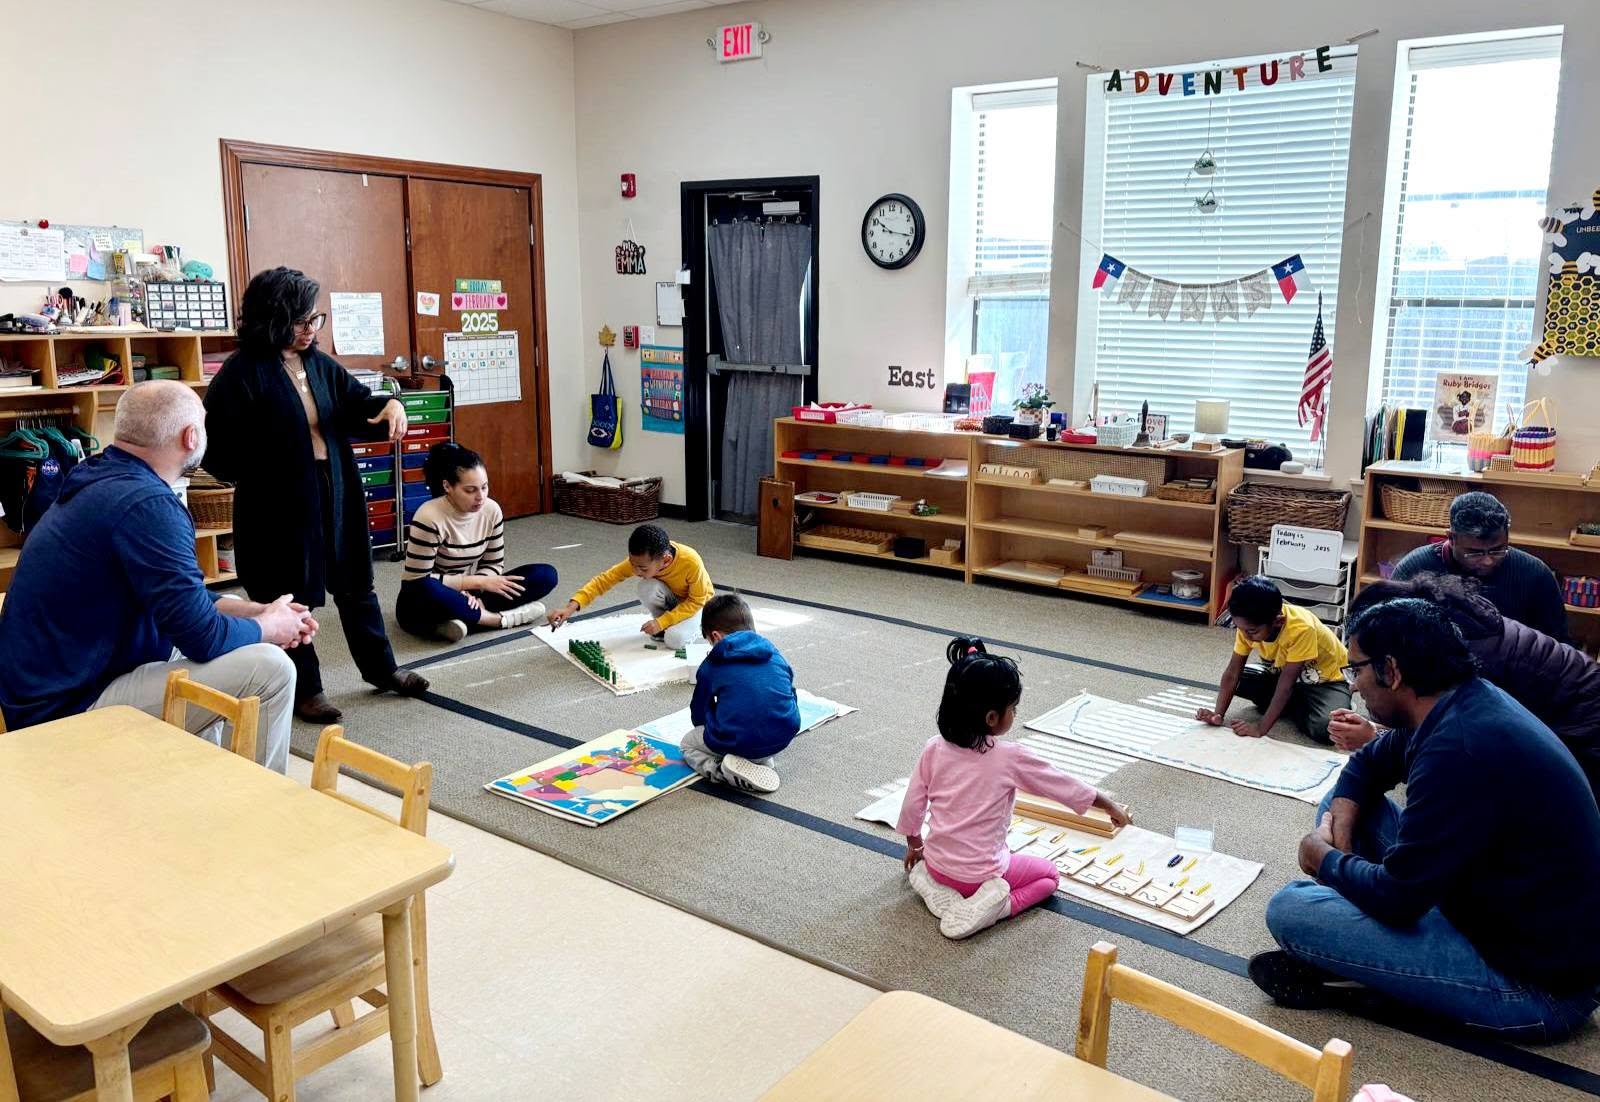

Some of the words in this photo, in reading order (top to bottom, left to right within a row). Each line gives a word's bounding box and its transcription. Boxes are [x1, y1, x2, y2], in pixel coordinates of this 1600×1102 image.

[723, 24, 752, 57] EXIT
[1107, 45, 1333, 96] ADVENTURE
[880, 209, 885, 217] 11
[889, 204, 896, 212] 12
[900, 206, 903, 214] 1
[873, 218, 880, 226] 10
[906, 214, 911, 222] 2
[906, 239, 911, 247] 4
[889, 252, 894, 260] 6
[899, 248, 904, 256] 5
[617, 256, 645, 273] EMMA
[465, 294, 495, 309] FEBRUARY
[1124, 280, 1266, 313] TEXAS
[461, 312, 499, 332] 2025
[888, 366, 936, 389] East
[1442, 379, 1461, 388] Ruby
[1463, 381, 1491, 390] Bridges
[1277, 530, 1295, 540] Today
[1276, 538, 1306, 550] February
